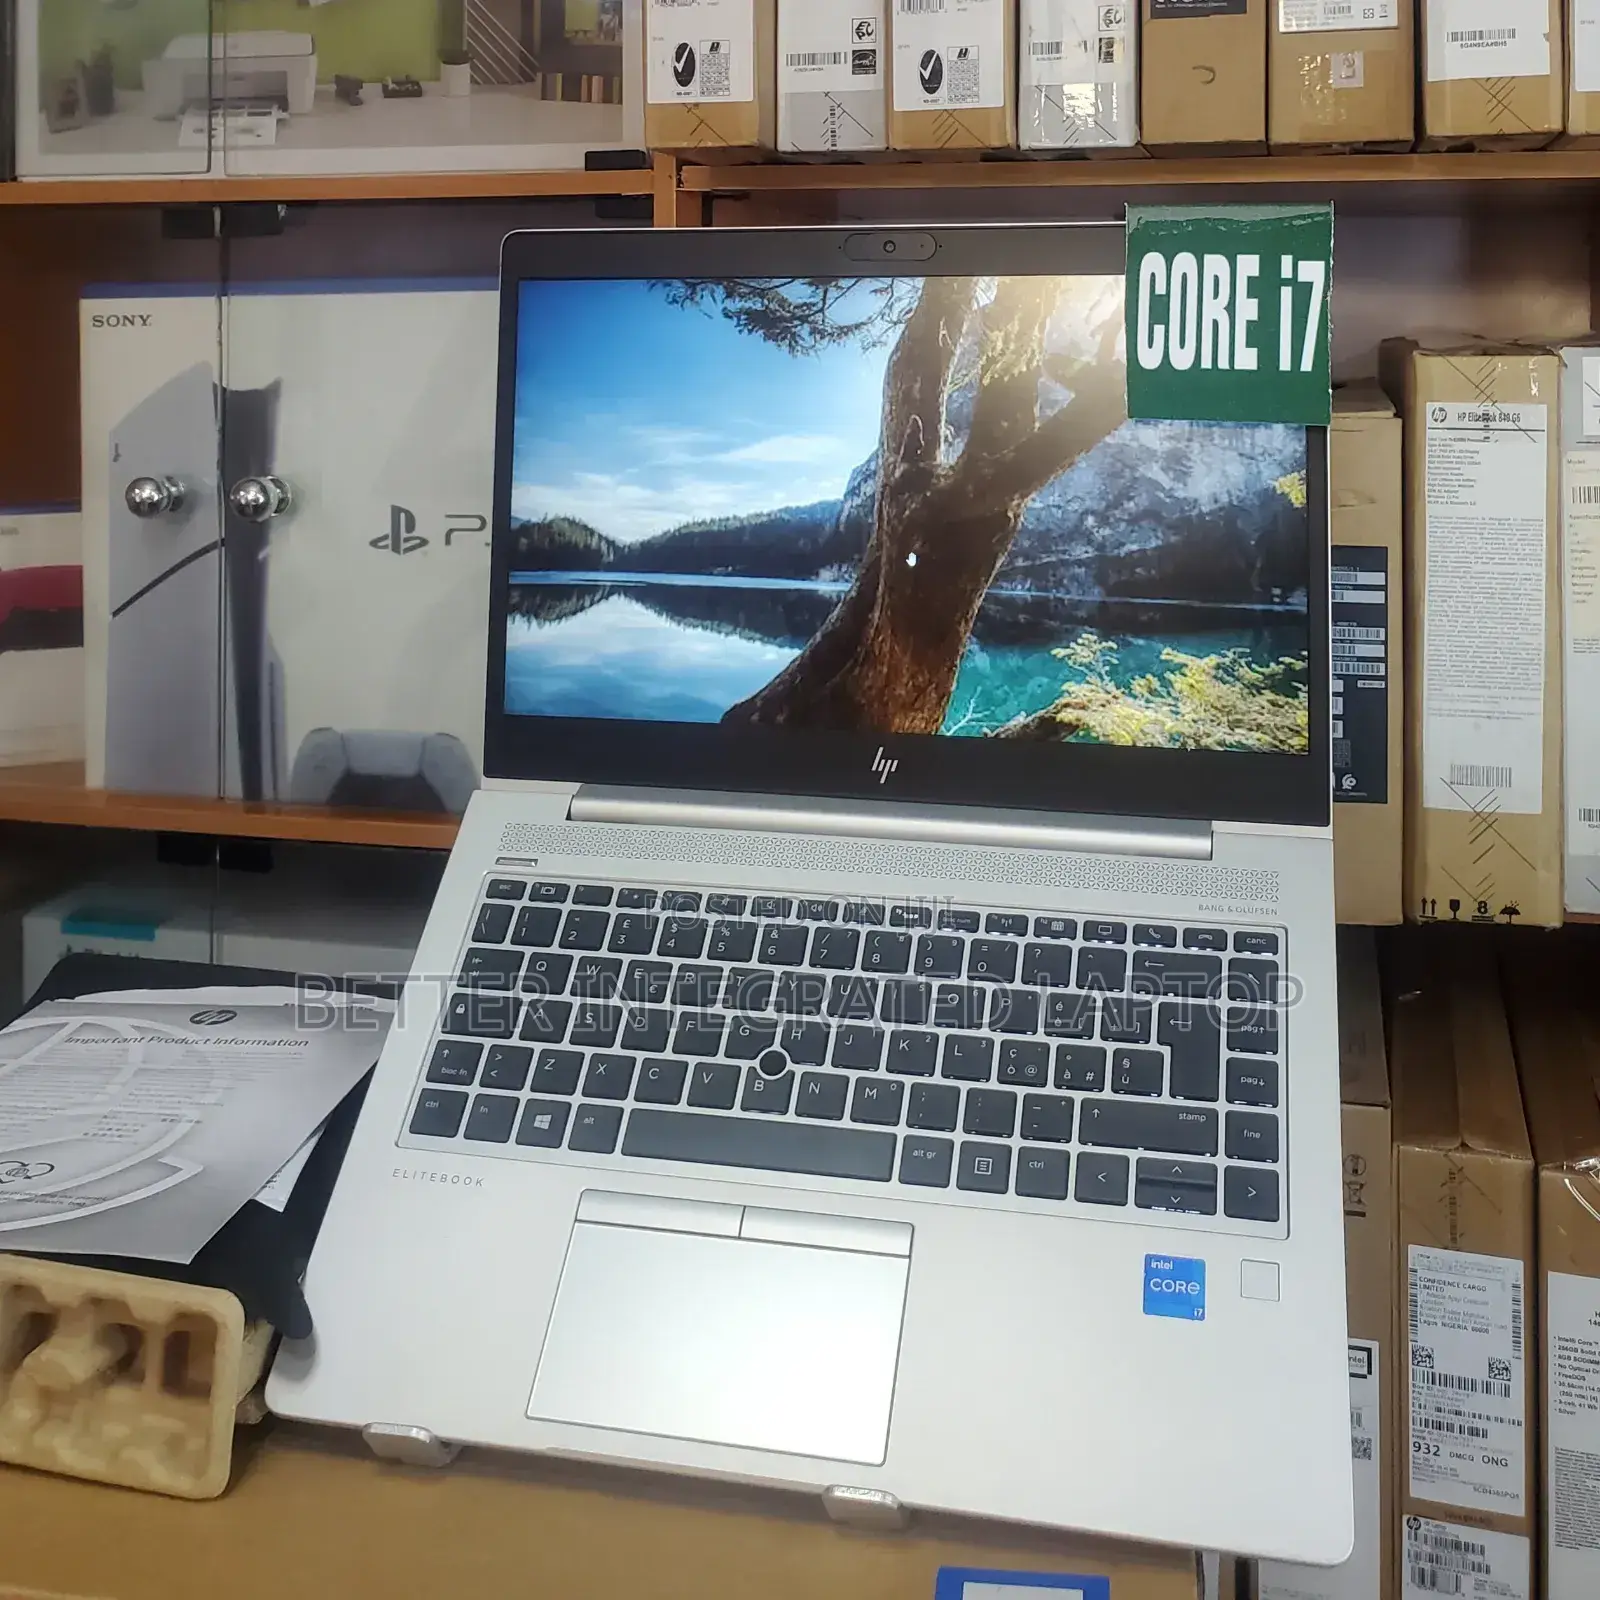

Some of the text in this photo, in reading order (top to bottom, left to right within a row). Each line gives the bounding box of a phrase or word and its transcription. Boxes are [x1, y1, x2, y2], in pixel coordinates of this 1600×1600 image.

[1137, 251, 1326, 372] CORE i7
[92, 314, 152, 328] SONY
[1198, 904, 1278, 916] BANG & OLUFSEN
[623, 919, 632, 928] £
[670, 922, 679, 933] $
[568, 931, 578, 941] 2
[720, 927, 730, 937] %
[770, 929, 780, 939] &
[617, 934, 625, 944] 3
[666, 938, 676, 948] 4
[1246, 937, 1267, 945] canc
[717, 942, 725, 951] 5
[767, 945, 776, 955] 6
[819, 949, 827, 959] 7
[871, 953, 881, 963] 8
[536, 961, 547, 972] Q
[924, 957, 933, 967] 9
[586, 965, 601, 975] W
[633, 968, 644, 978] E
[684, 973, 694, 984] R
[736, 976, 745, 986] T
[649, 985, 658, 994] €
[788, 981, 798, 991] Y
[840, 984, 849, 995] U
[947, 993, 959, 1004] O
[1000, 998, 1011, 1009] P
[532, 1008, 544, 1018] A
[584, 1013, 593, 1023] S
[634, 1017, 645, 1027] D
[685, 1020, 696, 1031] F
[739, 1025, 750, 1035] G
[791, 1029, 801, 1040] H
[64, 1035, 310, 1047] Important Product Information
[844, 1035, 853, 1046] J
[899, 1039, 910, 1050] K
[954, 1044, 963, 1056] L
[544, 1059, 555, 1069] Z
[595, 1063, 607, 1075] X
[648, 1068, 659, 1079] C
[1024, 1064, 1038, 1077] @
[1085, 1071, 1094, 1081] #
[702, 1072, 713, 1083] V
[753, 1080, 764, 1091] B
[808, 1083, 820, 1094] N
[864, 1087, 877, 1099] M
[425, 1099, 439, 1109] ctrl
[479, 1105, 489, 1114] fn
[583, 1115, 596, 1125] alt
[1178, 1111, 1207, 1123] stamp
[1243, 1129, 1261, 1140] fine
[912, 1148, 937, 1160] alt gr
[1029, 1159, 1045, 1170] ctrl
[392, 1168, 485, 1187] ELITEBOOK
[1150, 1258, 1173, 1270] intel
[1419, 1276, 1487, 1292] CONFIDENCE CARGO
[1419, 1284, 1445, 1293] LIMITED
[1193, 1307, 1204, 1317] i7
[1412, 1441, 1441, 1457] 932
[1481, 1454, 1509, 1468] ONG
